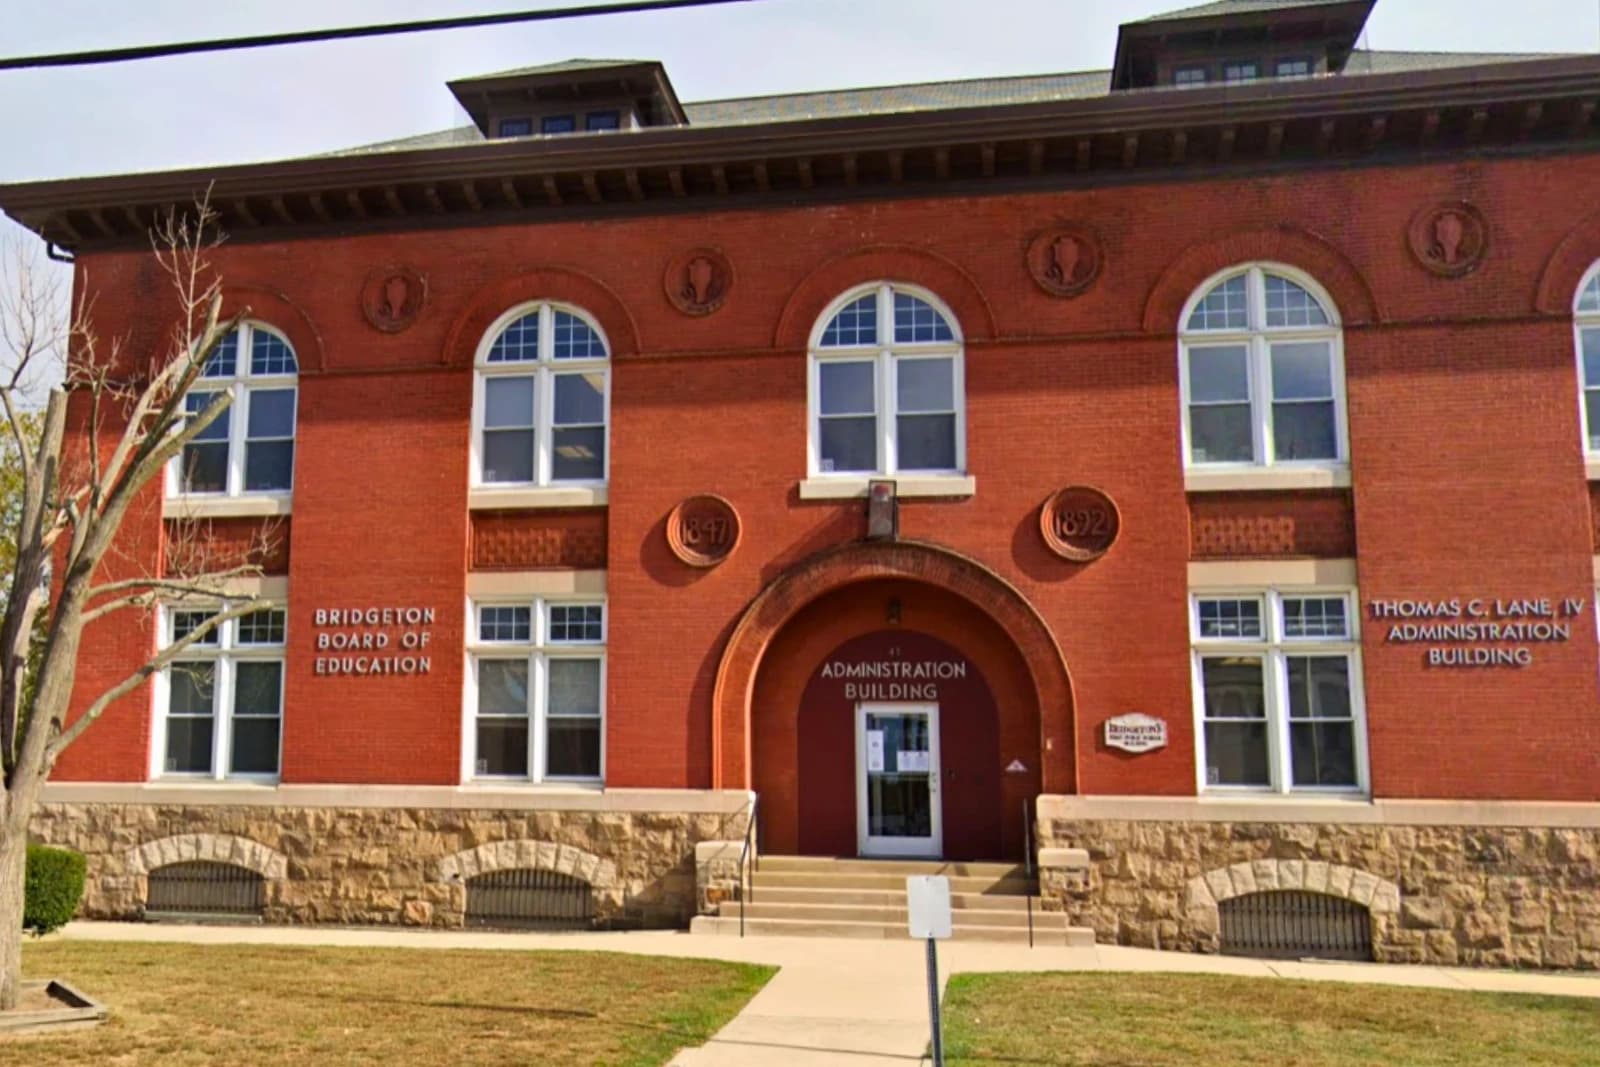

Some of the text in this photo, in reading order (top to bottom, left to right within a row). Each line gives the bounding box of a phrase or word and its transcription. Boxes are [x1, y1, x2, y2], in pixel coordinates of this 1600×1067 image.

[682, 517, 727, 544] 1847
[1056, 509, 1108, 536] 1892
[315, 608, 435, 625] BRIDGETON
[1371, 598, 1585, 618] THOMAS C. LANE, IV
[318, 631, 432, 649] BOARD OF
[1388, 623, 1570, 641] ADMINISTRATION
[315, 656, 432, 673] EDUCATION
[1429, 647, 1533, 665] BUILDING
[821, 661, 967, 678] ADMINISTRATION
[845, 683, 938, 699] BUILDING
